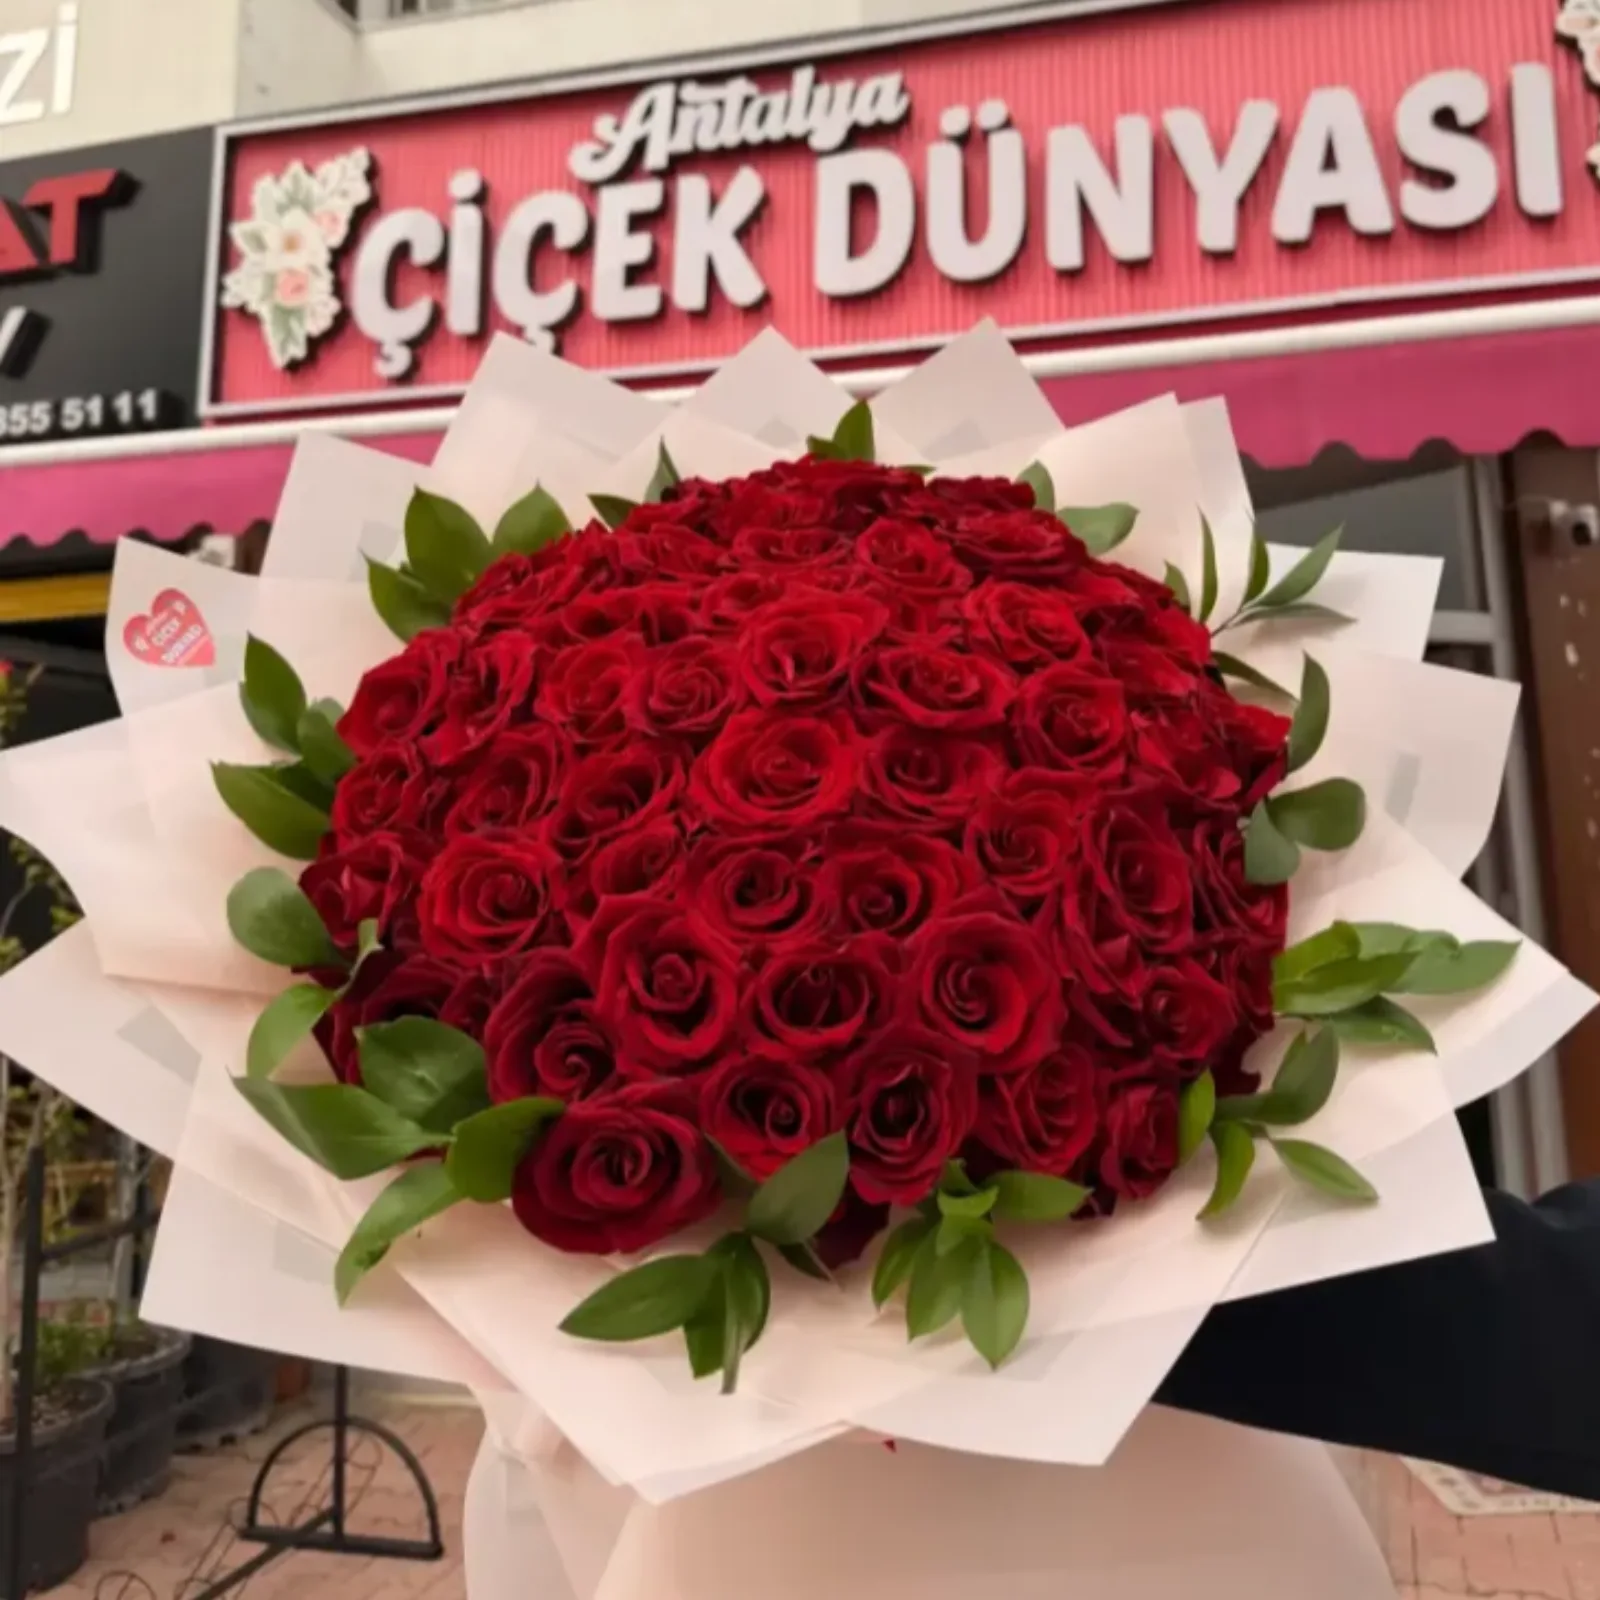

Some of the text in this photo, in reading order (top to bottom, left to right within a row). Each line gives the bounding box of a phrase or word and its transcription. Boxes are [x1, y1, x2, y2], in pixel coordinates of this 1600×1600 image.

[351, 62, 1563, 380] ÇİÇEK DÜNYASI
[568, 65, 909, 183] Antalya
